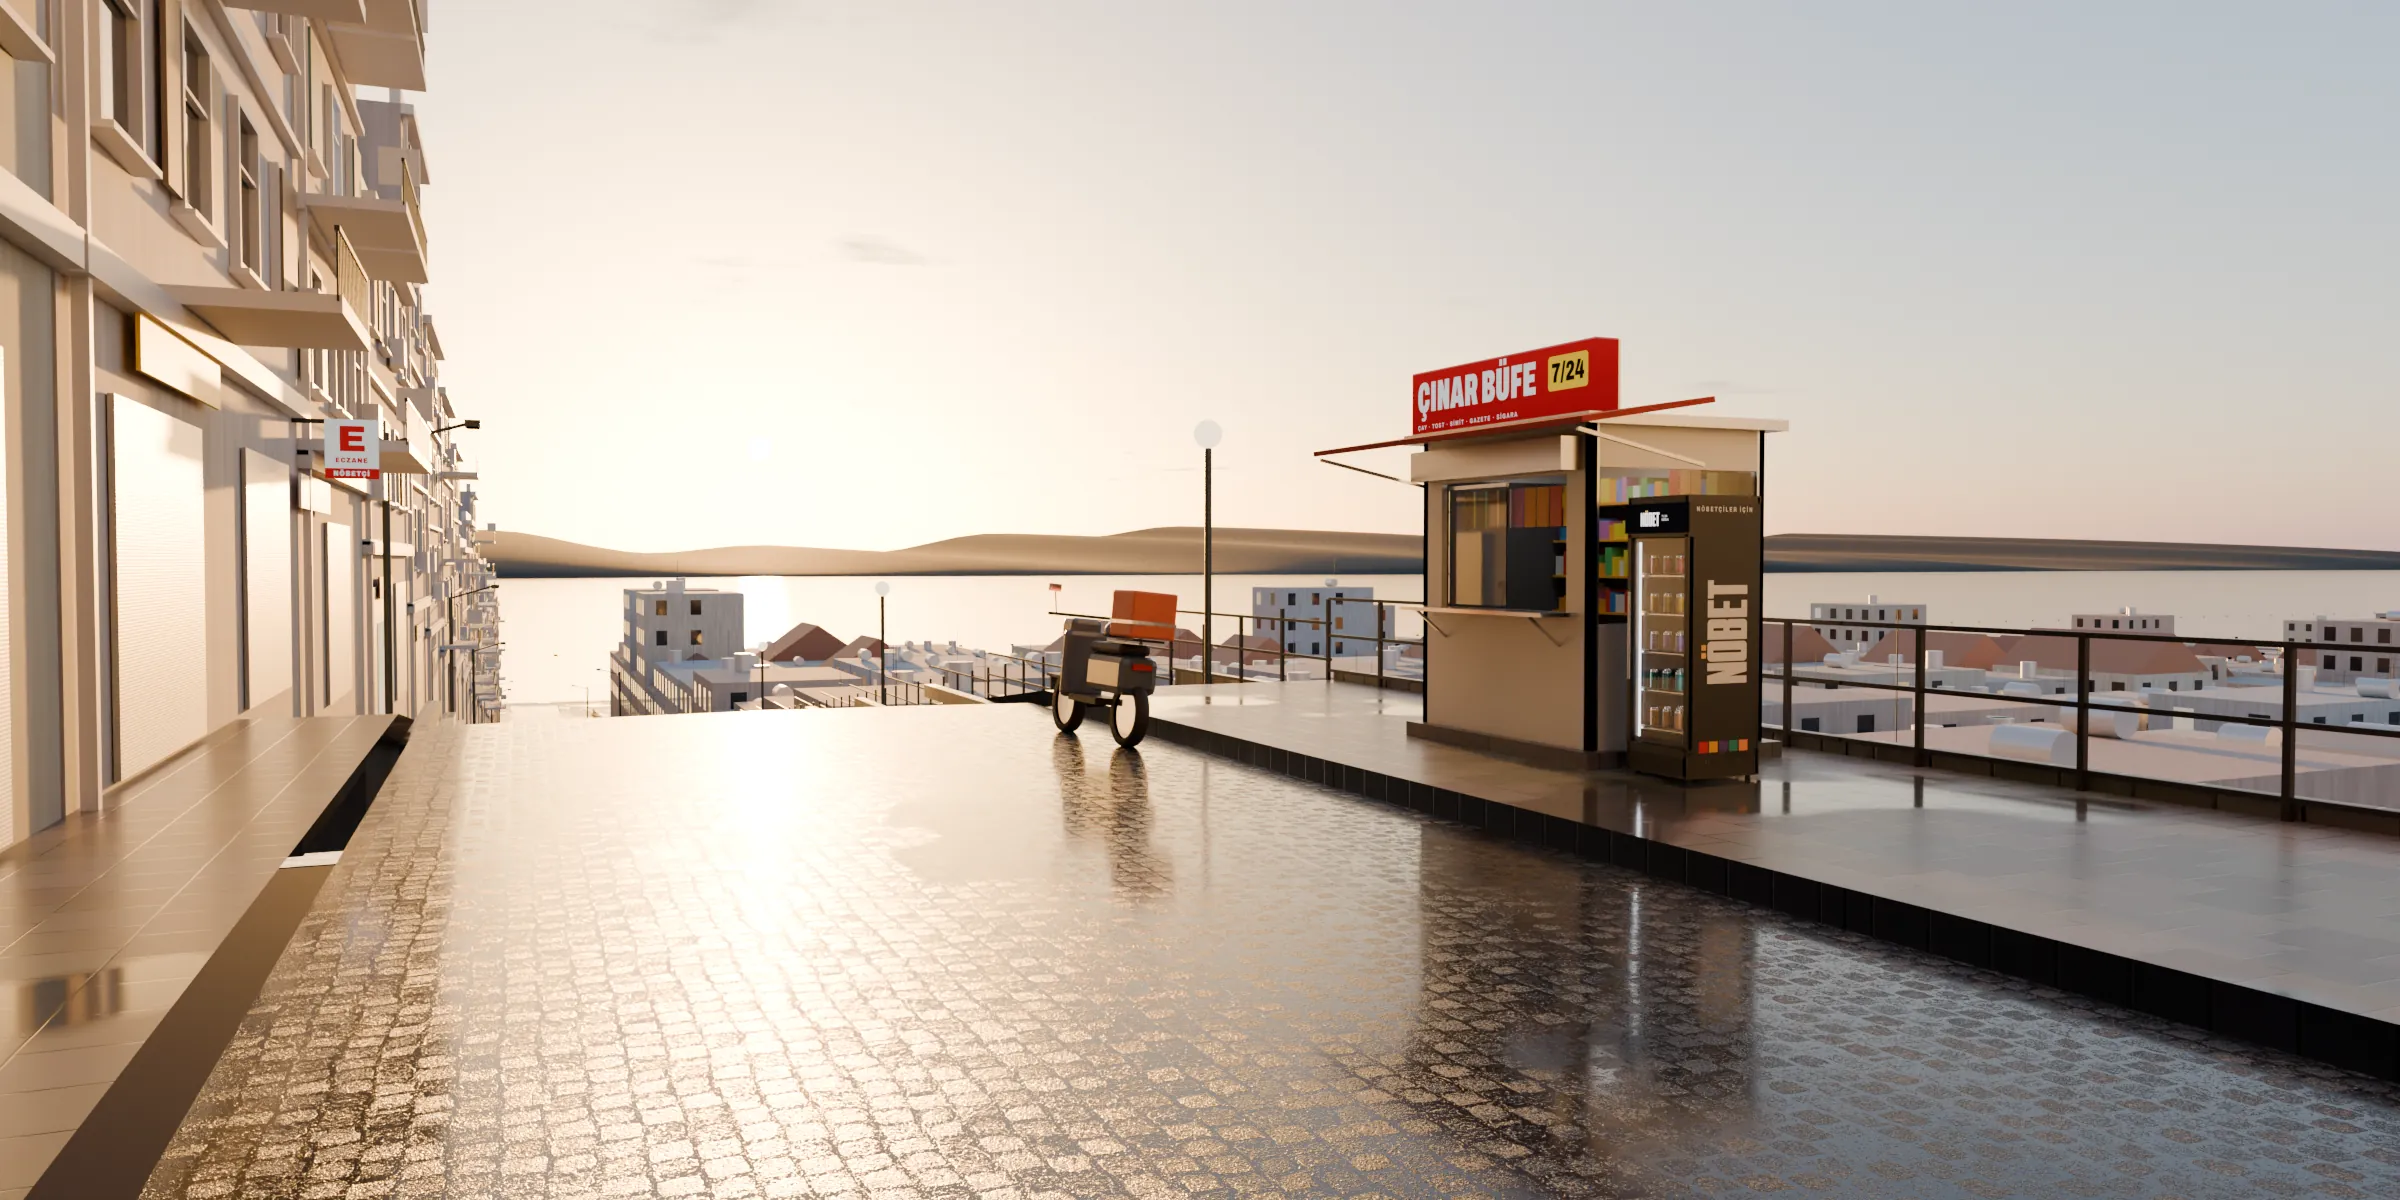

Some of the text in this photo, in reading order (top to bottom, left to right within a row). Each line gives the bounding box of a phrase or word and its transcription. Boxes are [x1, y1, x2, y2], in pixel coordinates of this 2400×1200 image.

[1551, 358, 1585, 383] 7/24
[1418, 358, 1536, 422] ÇINAR BÜFE
[1431, 422, 1445, 430] TOST
[1469, 415, 1491, 424] GAZETE
[1496, 411, 1518, 420] SİGARA
[340, 426, 365, 451] E
[333, 468, 371, 478] NÖBETÇİ
[1696, 504, 1754, 514] NÖBETÇİLER İÇİN
[1700, 579, 1749, 685] NÖBET
